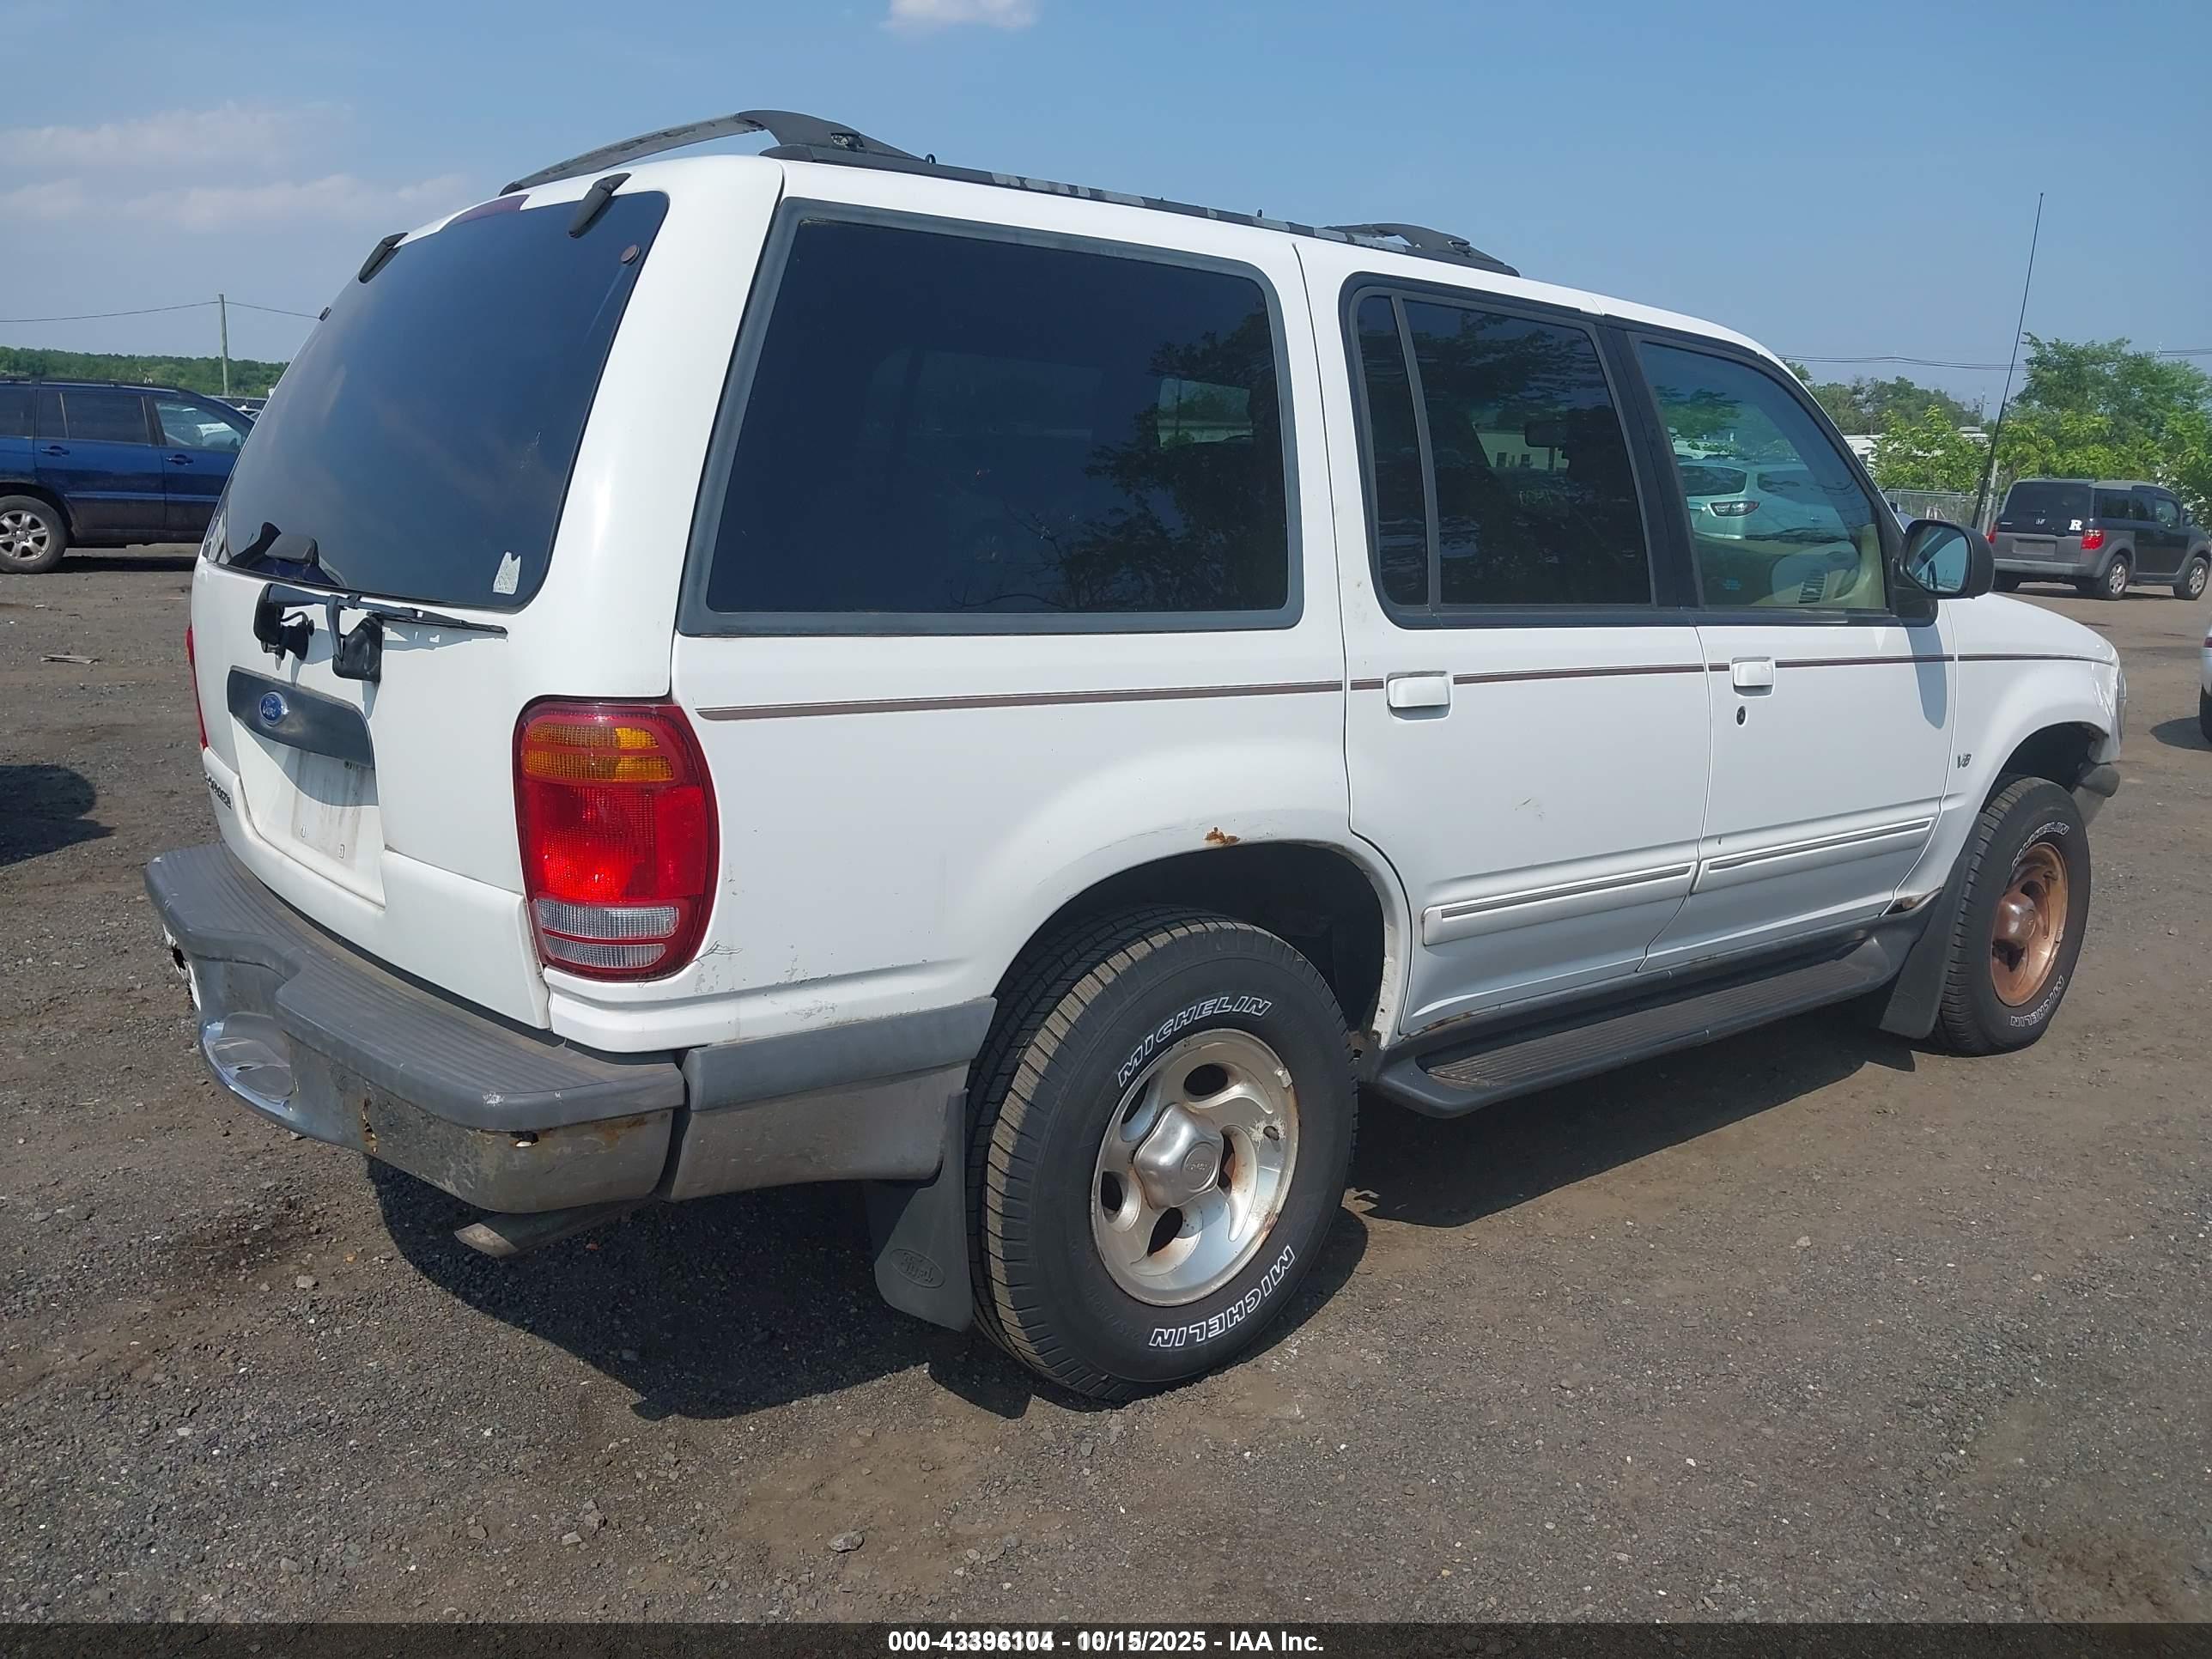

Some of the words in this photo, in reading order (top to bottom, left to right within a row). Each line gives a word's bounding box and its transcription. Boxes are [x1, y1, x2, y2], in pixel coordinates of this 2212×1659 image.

[2069, 519, 2082, 531] R
[1957, 753, 1972, 769] V8
[2009, 975, 2066, 1027] MICHELIN
[1117, 995, 1273, 1089] MICHELIN
[1148, 1244, 1297, 1348] MICHELIN
